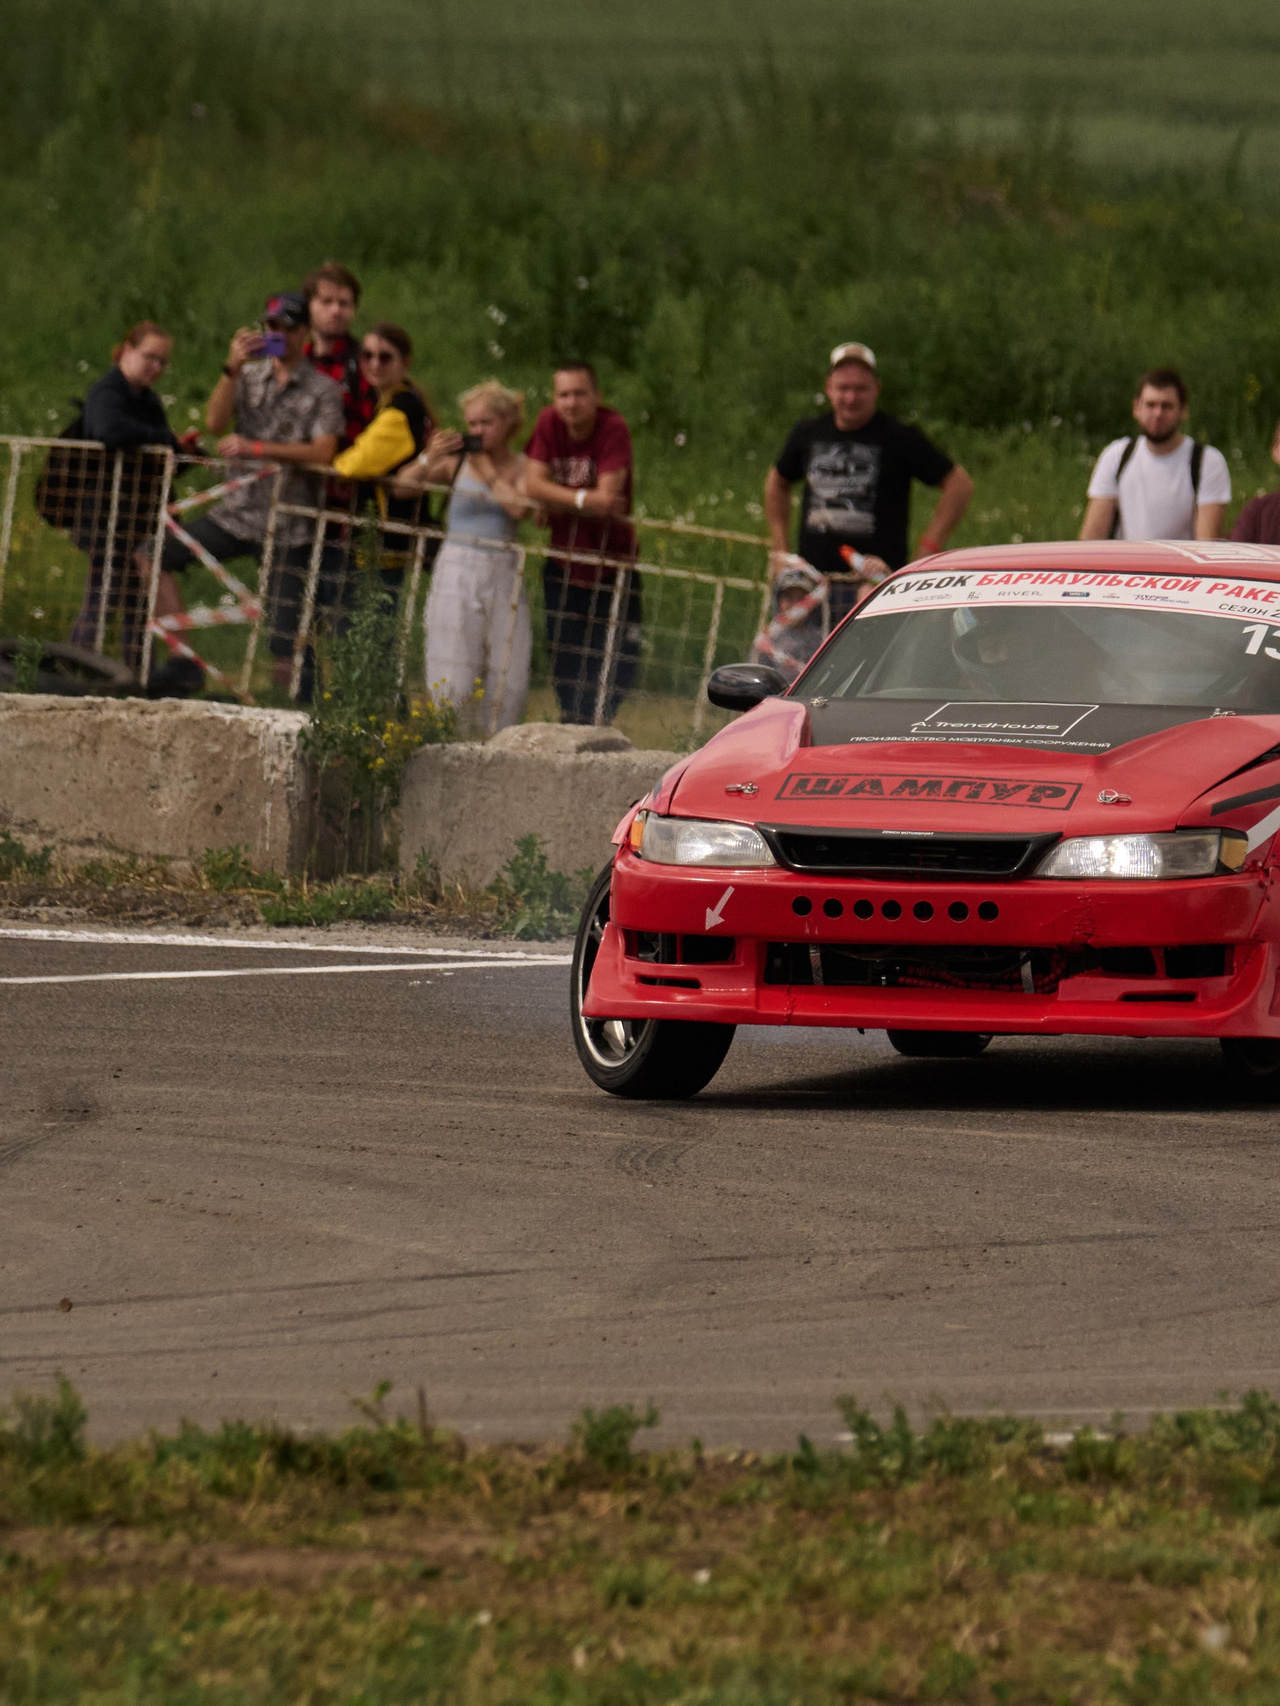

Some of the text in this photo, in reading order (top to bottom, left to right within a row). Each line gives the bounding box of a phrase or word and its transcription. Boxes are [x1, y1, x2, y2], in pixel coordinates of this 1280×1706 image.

[882, 574, 975, 597] КУБОК
[976, 572, 1204, 592] БАРНАУЛЬСКОЙ
[1218, 602, 1269, 616] СЕЗОН
[936, 722, 1060, 730] TrendHouse
[1025, 739, 1112, 748] СООРУЖЕНИЙ
[789, 777, 1067, 804] ШАМПУР
